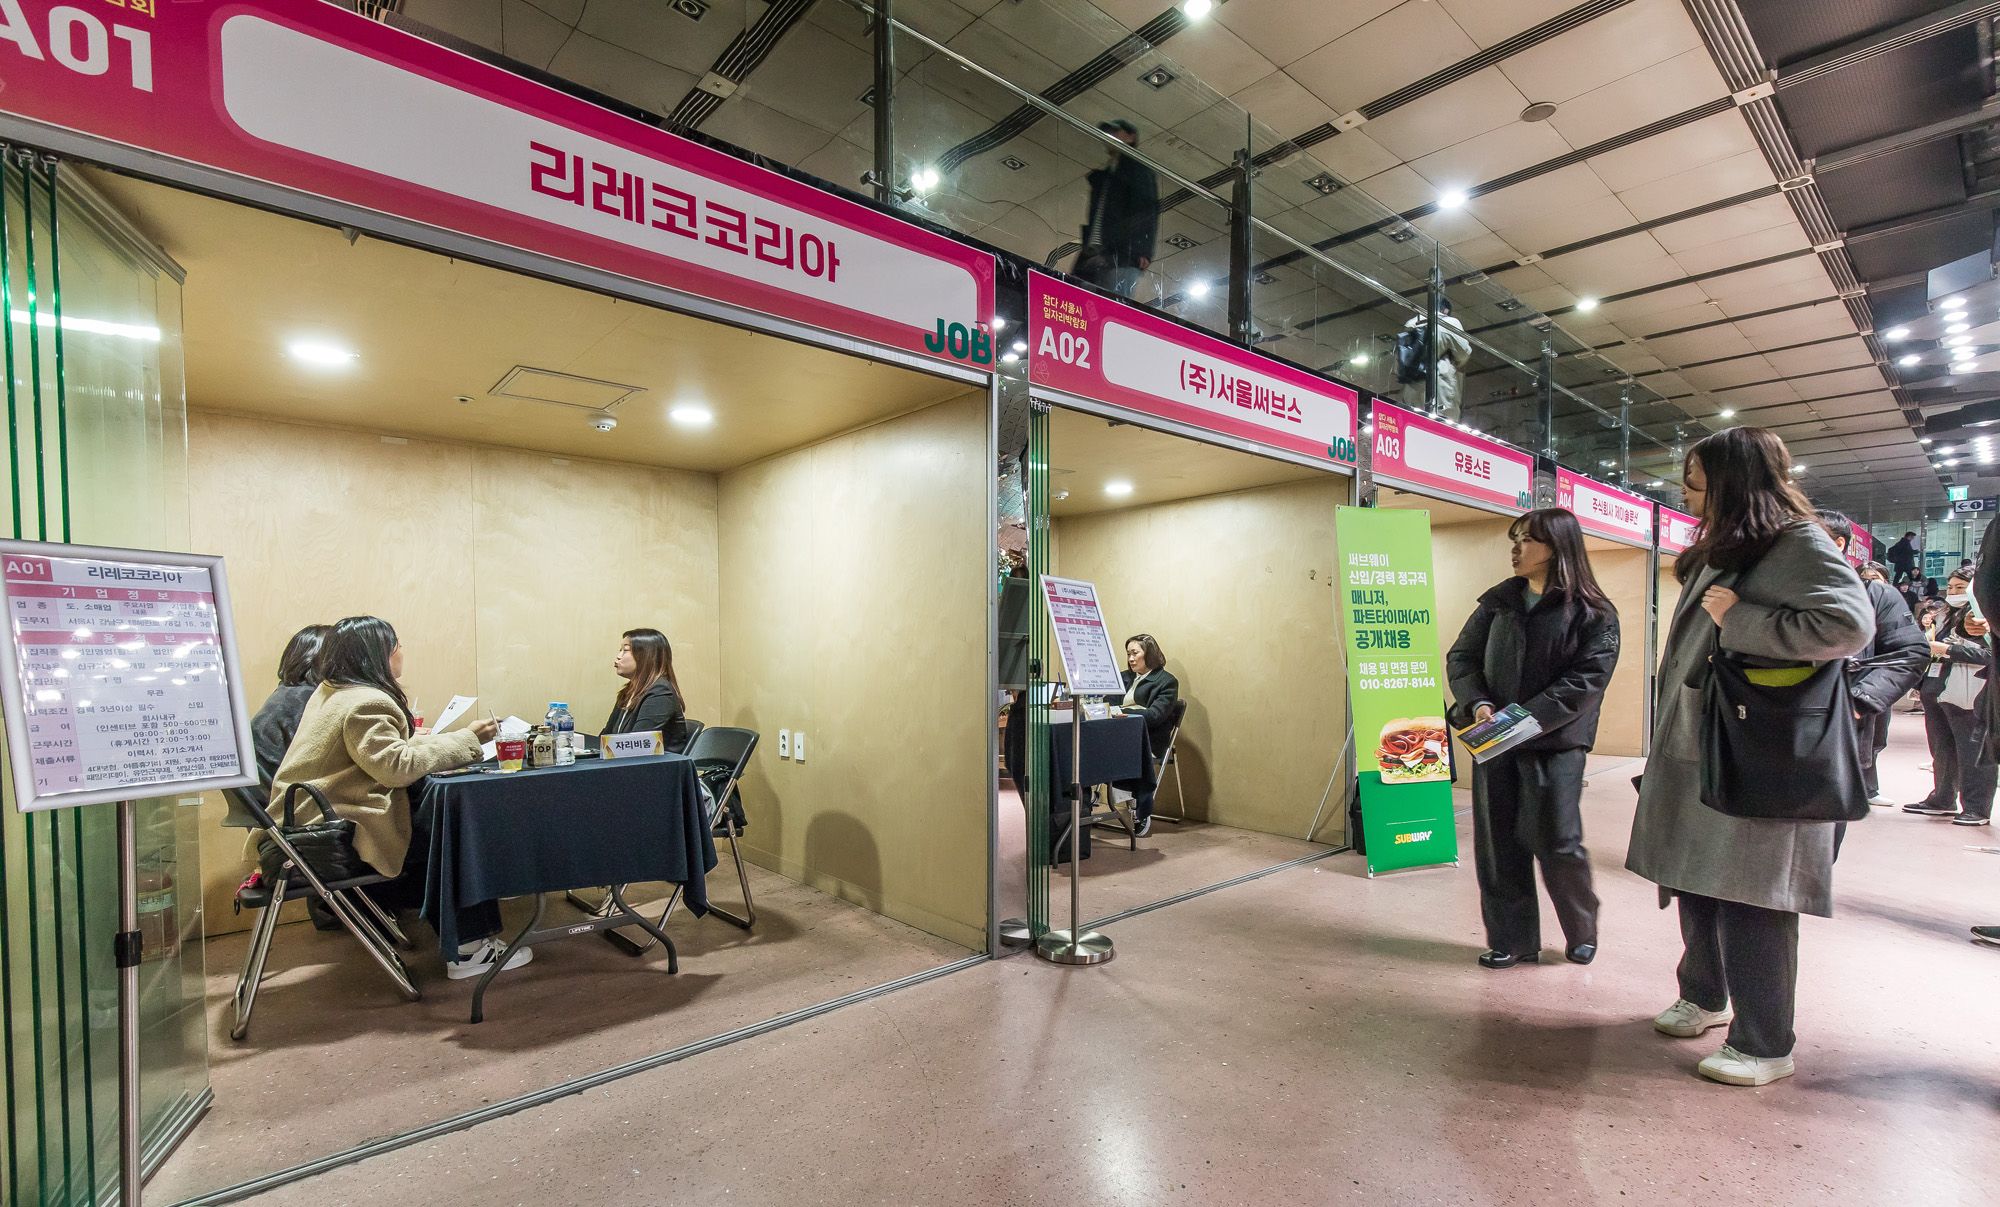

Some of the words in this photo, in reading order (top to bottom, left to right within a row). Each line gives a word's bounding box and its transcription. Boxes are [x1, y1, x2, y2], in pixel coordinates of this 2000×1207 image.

[530, 141, 840, 283] 리레코코리아
[1043, 294, 1058, 309] 잡다
[1060, 300, 1083, 317] 서울시
[1043, 306, 1088, 331] 일자리박람회
[924, 317, 993, 365] JOB
[1038, 326, 1091, 370] A02
[1180, 359, 1302, 424] (주)서울써브스
[1327, 435, 1357, 463] JOB
[1375, 433, 1400, 460] A03
[1454, 451, 1491, 481] 유호스트
[1558, 491, 1572, 510] A04
[6, 561, 45, 575] A01
[1348, 553, 1389, 567] 써브웨이
[88, 567, 182, 583] 리레코코리아
[1349, 570, 1396, 585] 신입/경력
[1397, 570, 1428, 586] 정규직
[1351, 589, 1389, 606] 매니저,
[84, 604, 112, 612] 소매업
[19, 616, 50, 625] 근무지
[1353, 608, 1430, 625] 파트타이머(AT)
[1355, 629, 1411, 650] 공개채용
[19, 648, 59, 657] 집직종
[1359, 662, 1378, 676] 채용
[1380, 662, 1388, 675] 및
[1390, 662, 1409, 675] 면접
[1410, 661, 1428, 674] 문의
[1360, 676, 1436, 690] 010-8267-8144
[32, 740, 73, 750] 근무시간
[162, 745, 204, 755] 자기소개서
[615, 738, 652, 751] 자리비움
[1395, 830, 1432, 845] SUBWAY
